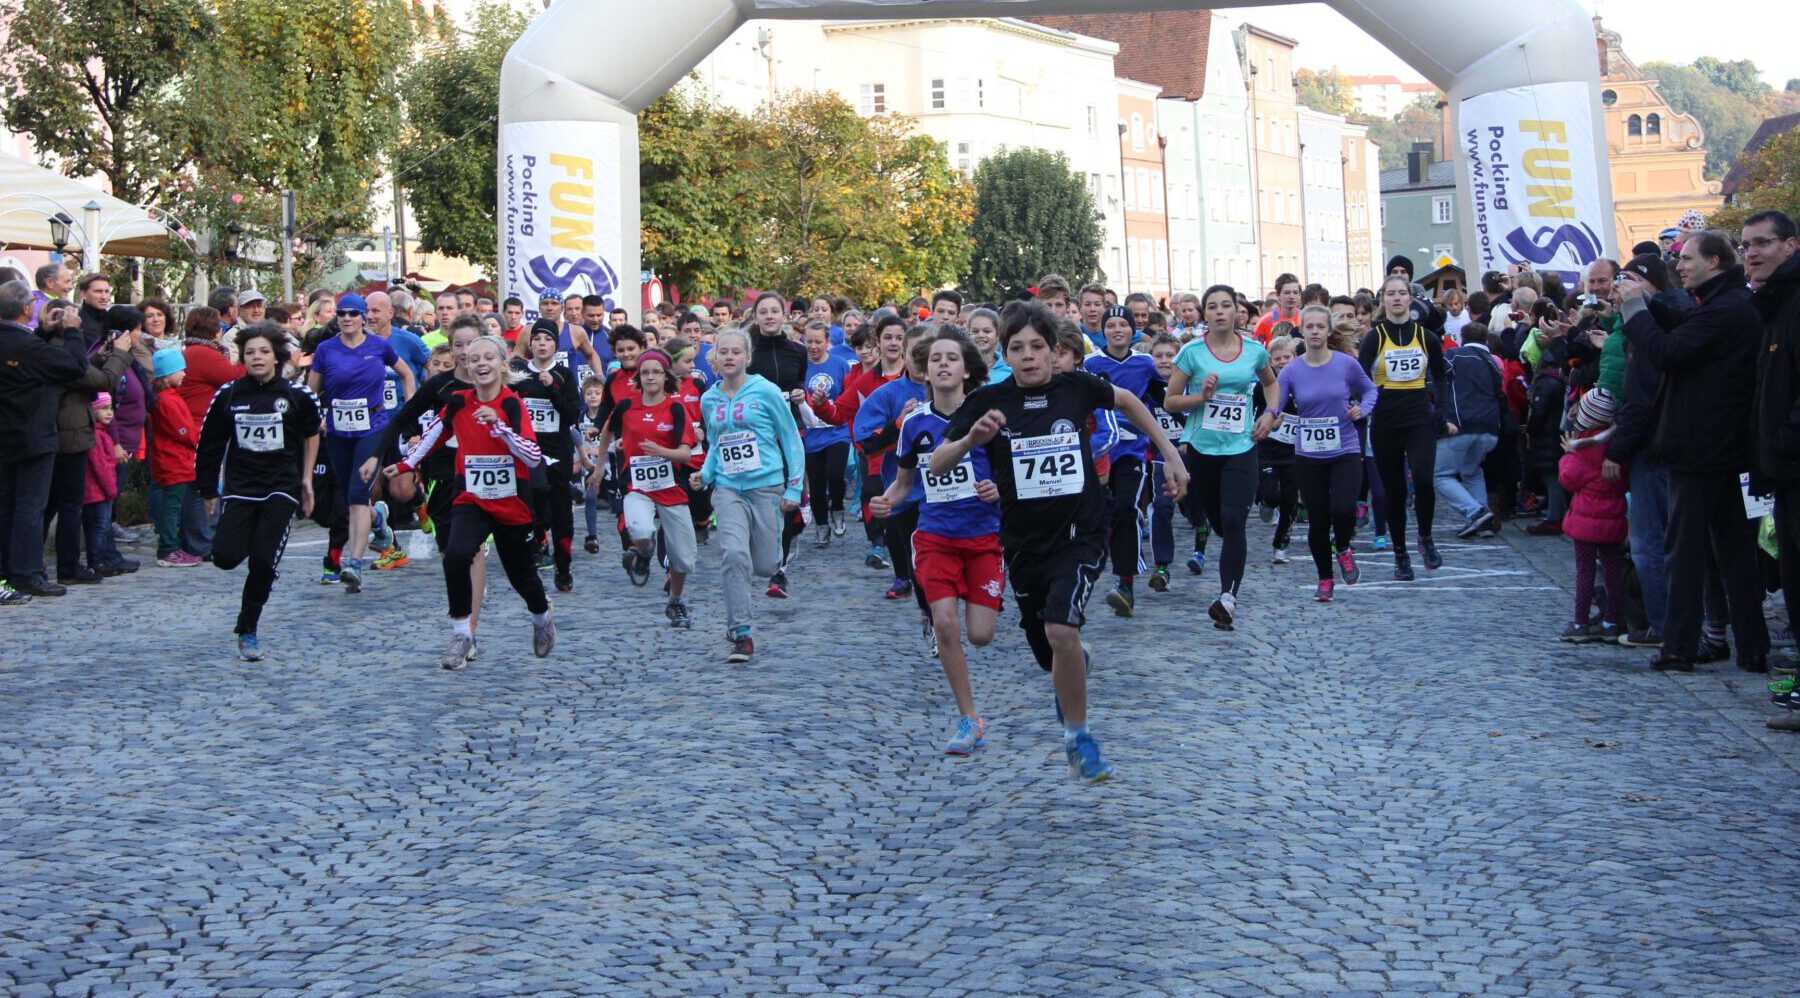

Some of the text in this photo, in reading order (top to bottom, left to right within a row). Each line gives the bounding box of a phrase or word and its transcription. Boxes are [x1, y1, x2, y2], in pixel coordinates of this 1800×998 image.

[1487, 126, 1509, 211] Pocking
[520, 154, 538, 237] Pocking
[506, 154, 520, 299] www.funsport-
[1389, 358, 1420, 372] 752
[336, 409, 365, 422] 716
[1208, 404, 1242, 421] 743
[240, 426, 277, 440] 741
[1304, 428, 1336, 441] 708
[722, 444, 754, 462] 863
[635, 464, 669, 481] 809
[1019, 453, 1077, 480] 742
[470, 469, 511, 486] 703
[925, 465, 969, 487] 689
[1039, 478, 1062, 486] Manuel
